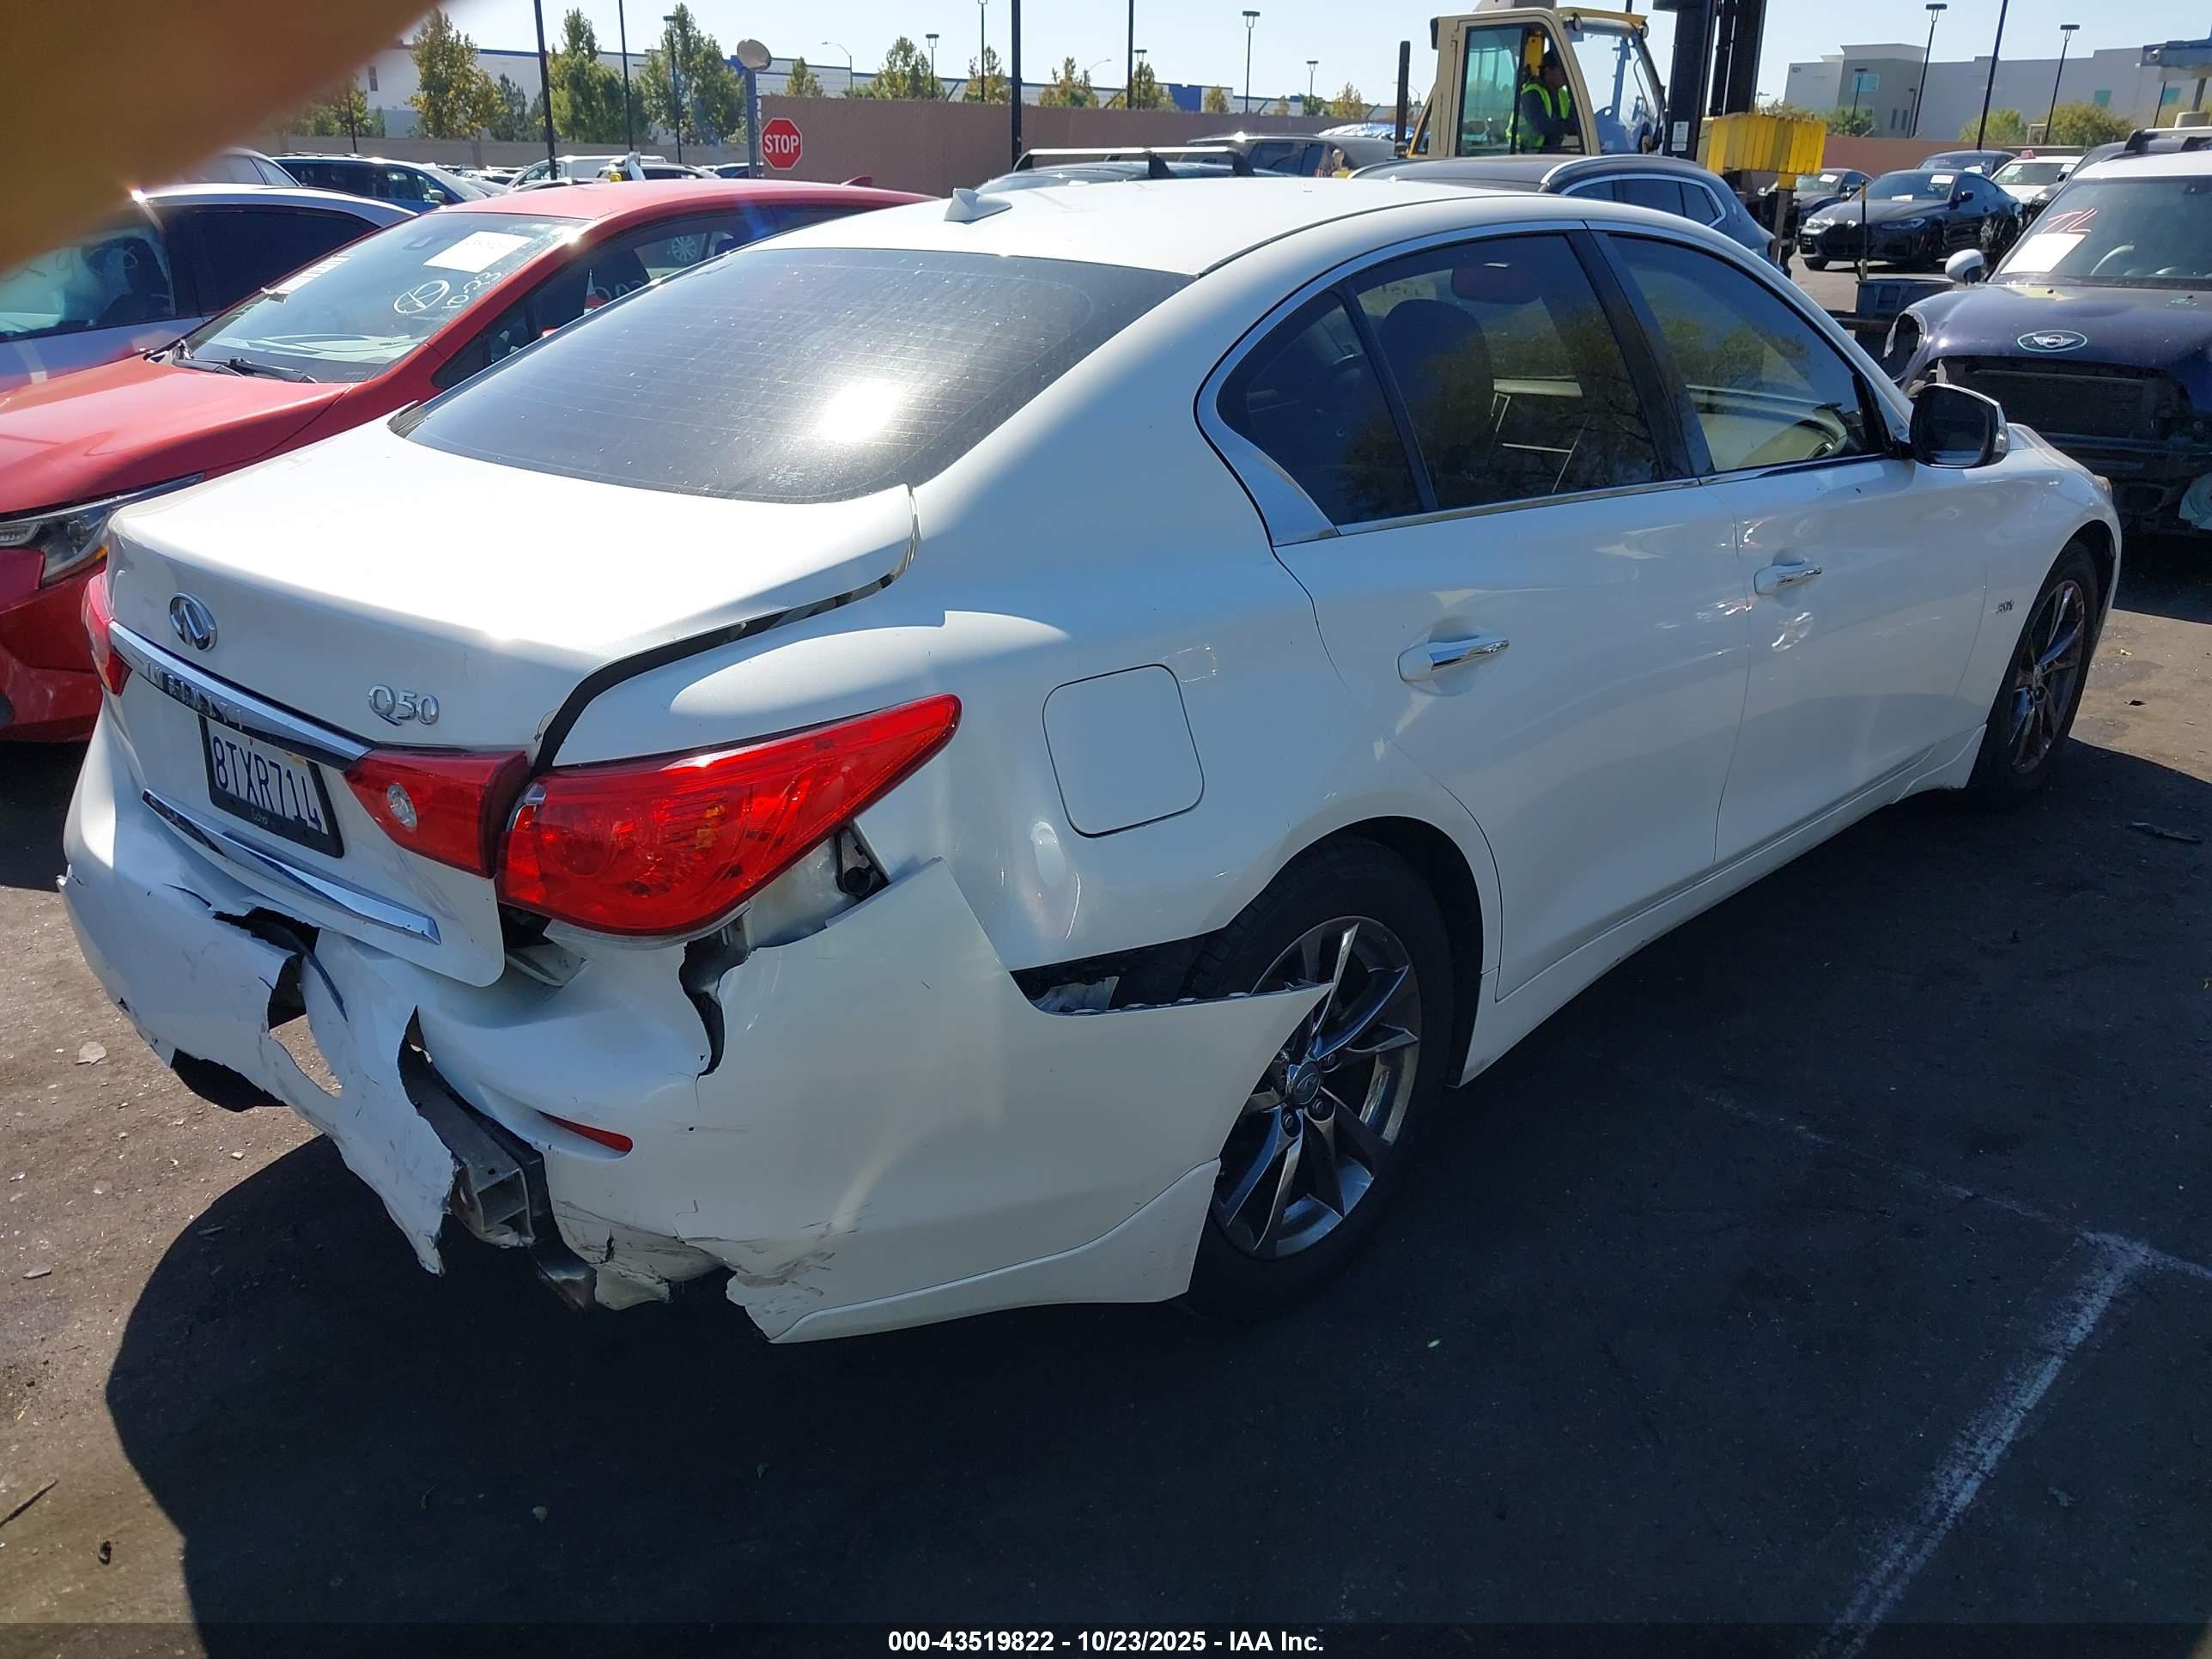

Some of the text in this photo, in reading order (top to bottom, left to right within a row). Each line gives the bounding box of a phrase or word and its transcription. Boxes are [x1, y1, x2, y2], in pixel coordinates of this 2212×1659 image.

[763, 134, 799, 154] STOP
[368, 684, 440, 726] Q50
[212, 735, 323, 832] 8TXR714
